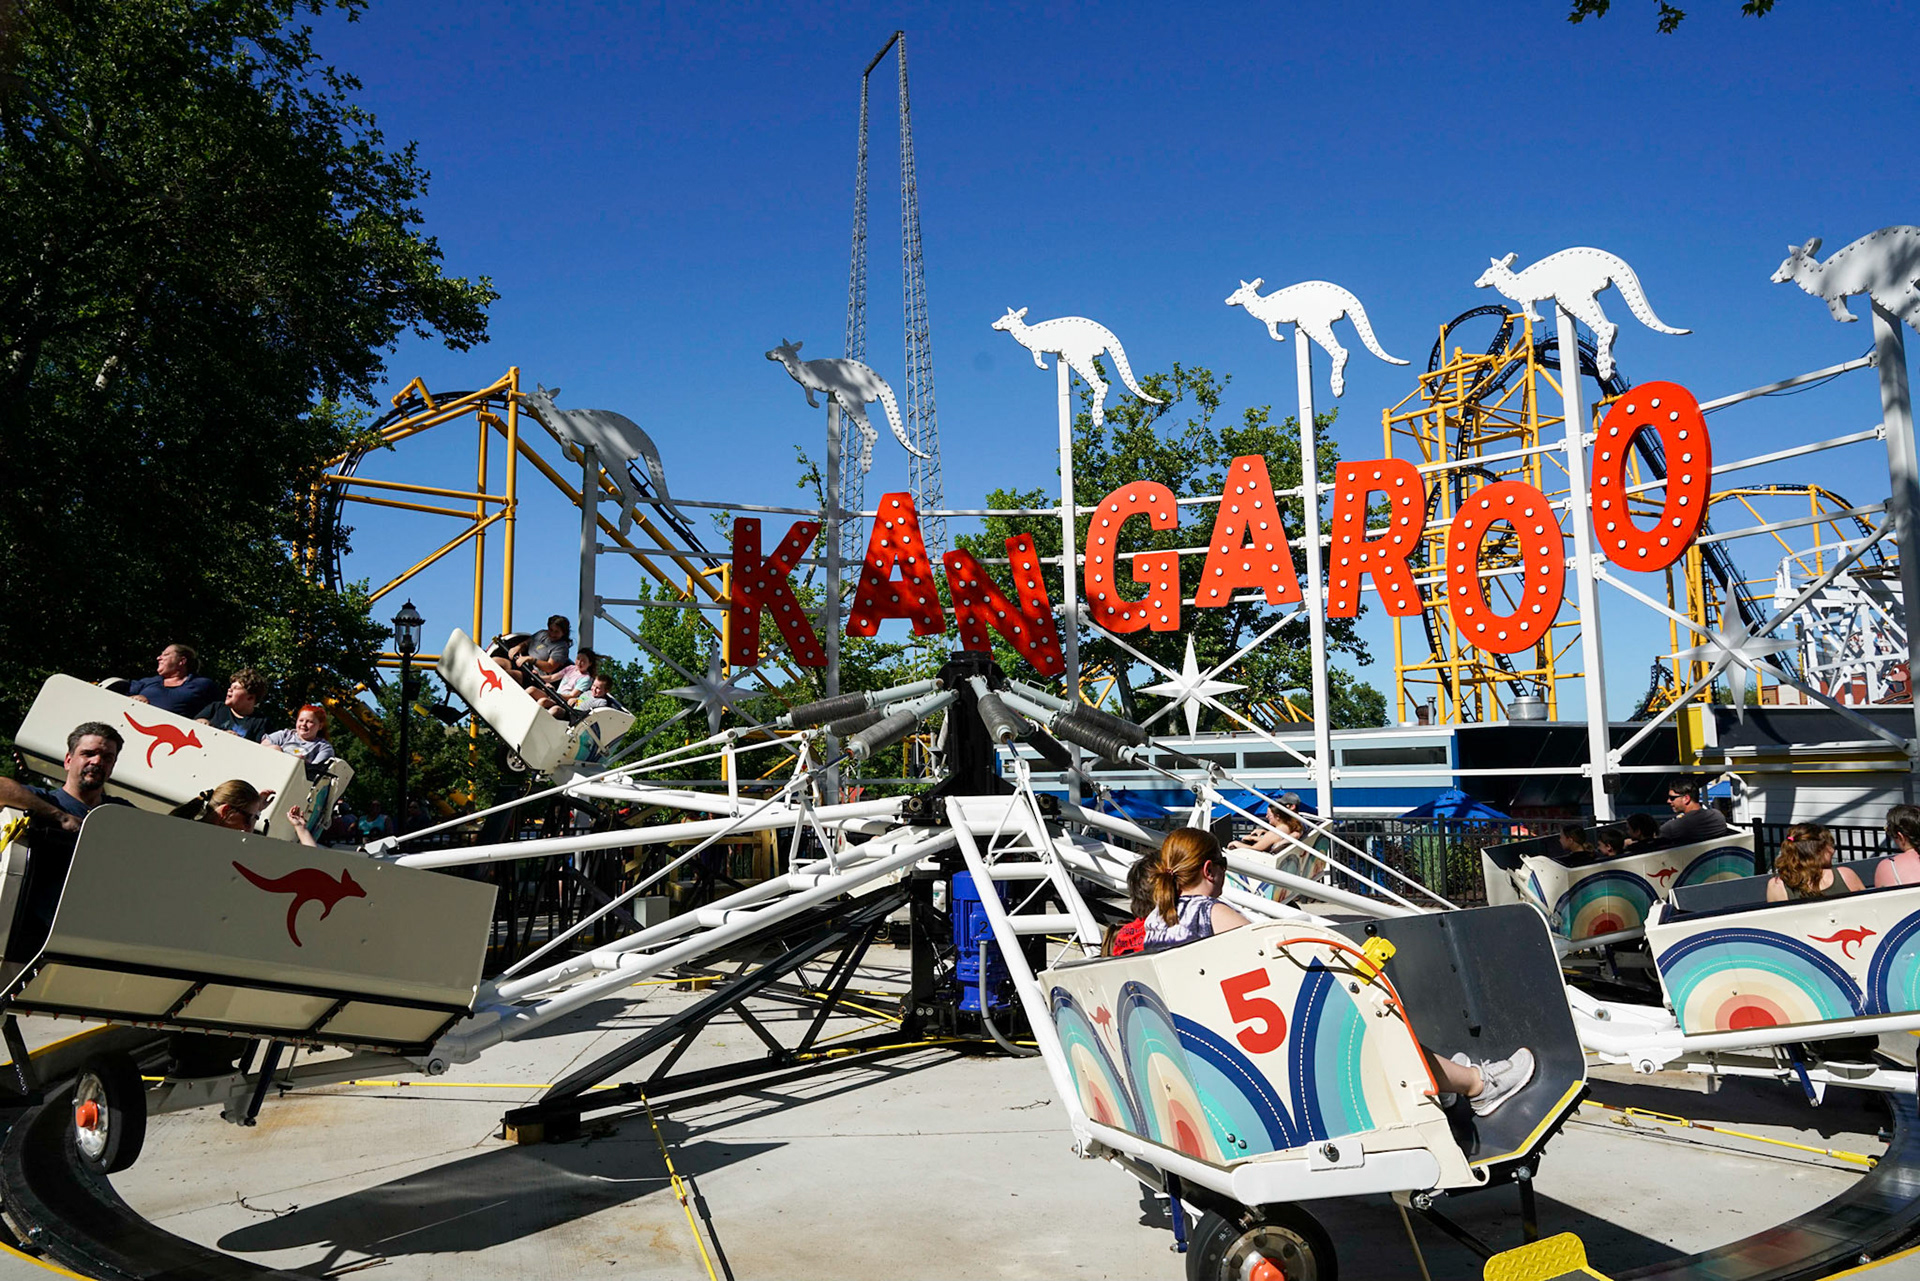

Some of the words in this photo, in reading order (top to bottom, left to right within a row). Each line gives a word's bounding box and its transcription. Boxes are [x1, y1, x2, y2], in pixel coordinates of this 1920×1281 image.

[729, 380, 1712, 677] KANGAROO
[980, 921, 988, 933] 2
[1220, 967, 1287, 1054] 5
